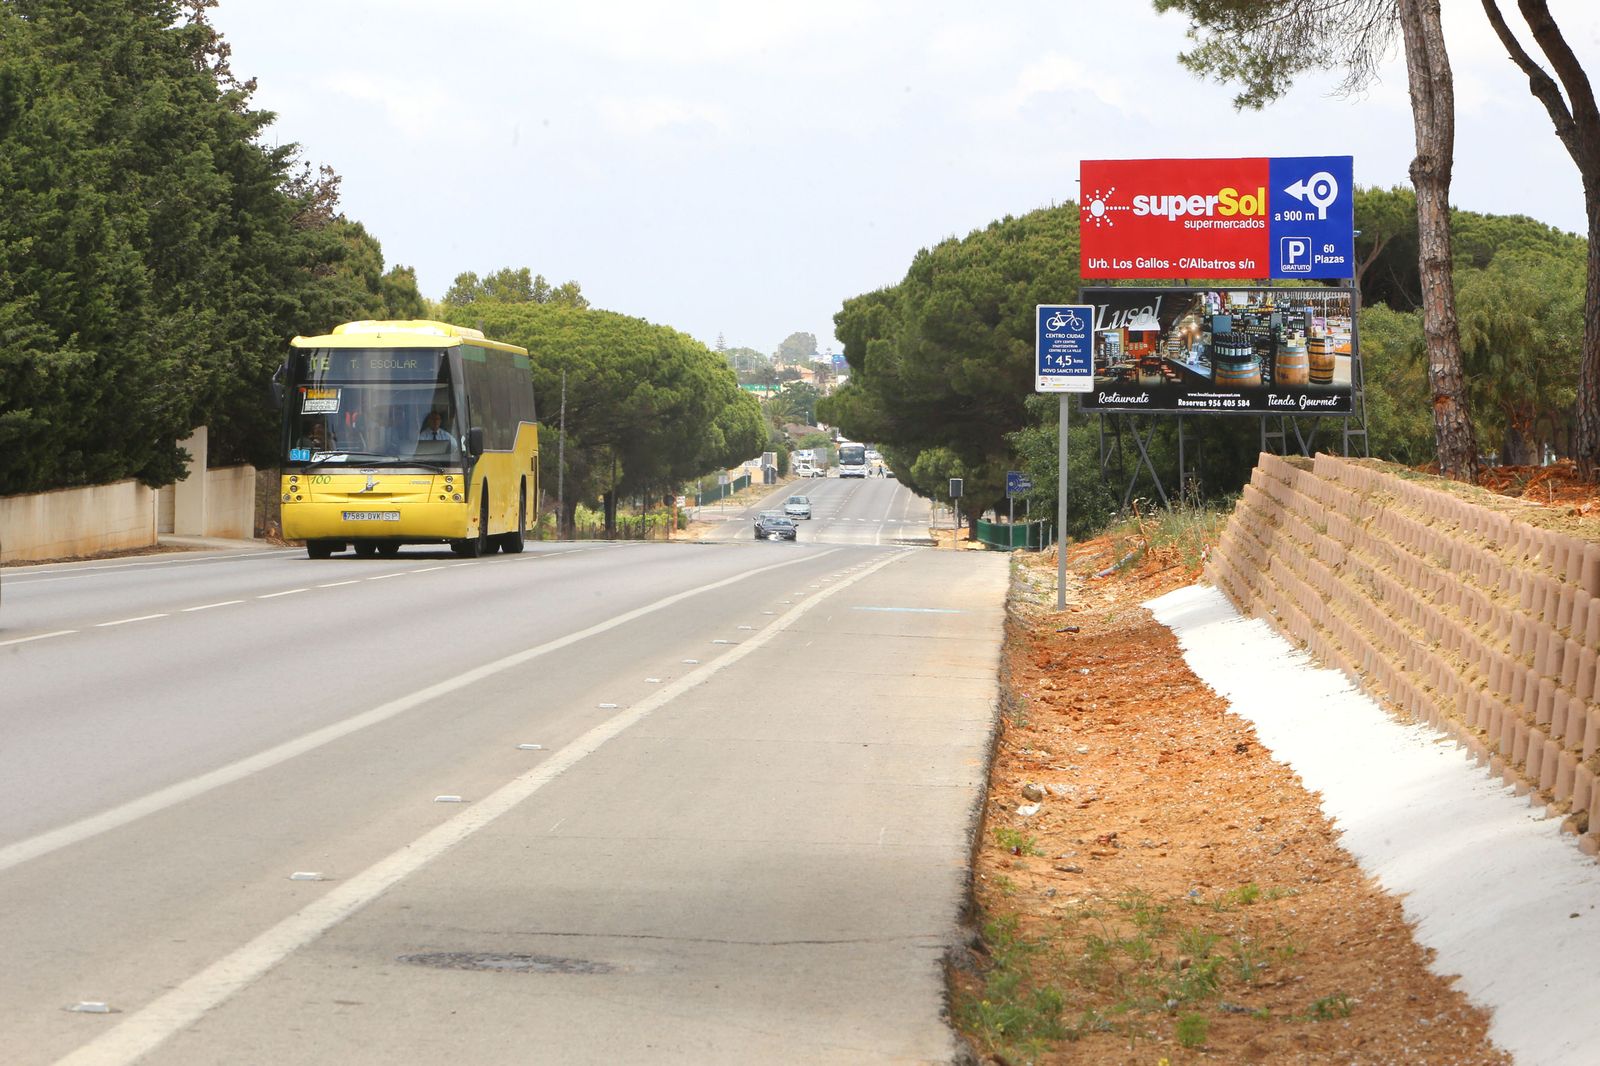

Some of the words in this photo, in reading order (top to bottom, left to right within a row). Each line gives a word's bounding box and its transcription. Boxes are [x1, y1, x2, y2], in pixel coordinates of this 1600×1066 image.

[1132, 187, 1266, 221] superSol
[1274, 212, 1282, 221] a
[1283, 210, 1302, 221] 900
[1305, 212, 1315, 221] m
[1184, 218, 1265, 230] supermercados
[1289, 241, 1305, 264] P
[1323, 244, 1334, 253] 60
[1088, 258, 1110, 269] Urb.
[1113, 258, 1132, 269] Los
[1136, 257, 1169, 269] Gallos
[1179, 258, 1236, 269] C/Albatros
[1238, 258, 1255, 269] s/n
[1315, 255, 1344, 264] Plazas
[1094, 295, 1162, 331] Lusol
[370, 360, 417, 369] ESCOLAR
[1055, 355, 1072, 367] 4,5
[1098, 392, 1150, 404] Restaurante
[1178, 398, 1207, 406] Reservas
[1268, 394, 1296, 406] Tienda
[1299, 394, 1338, 410] Gourmet
[311, 475, 332, 484] 100
